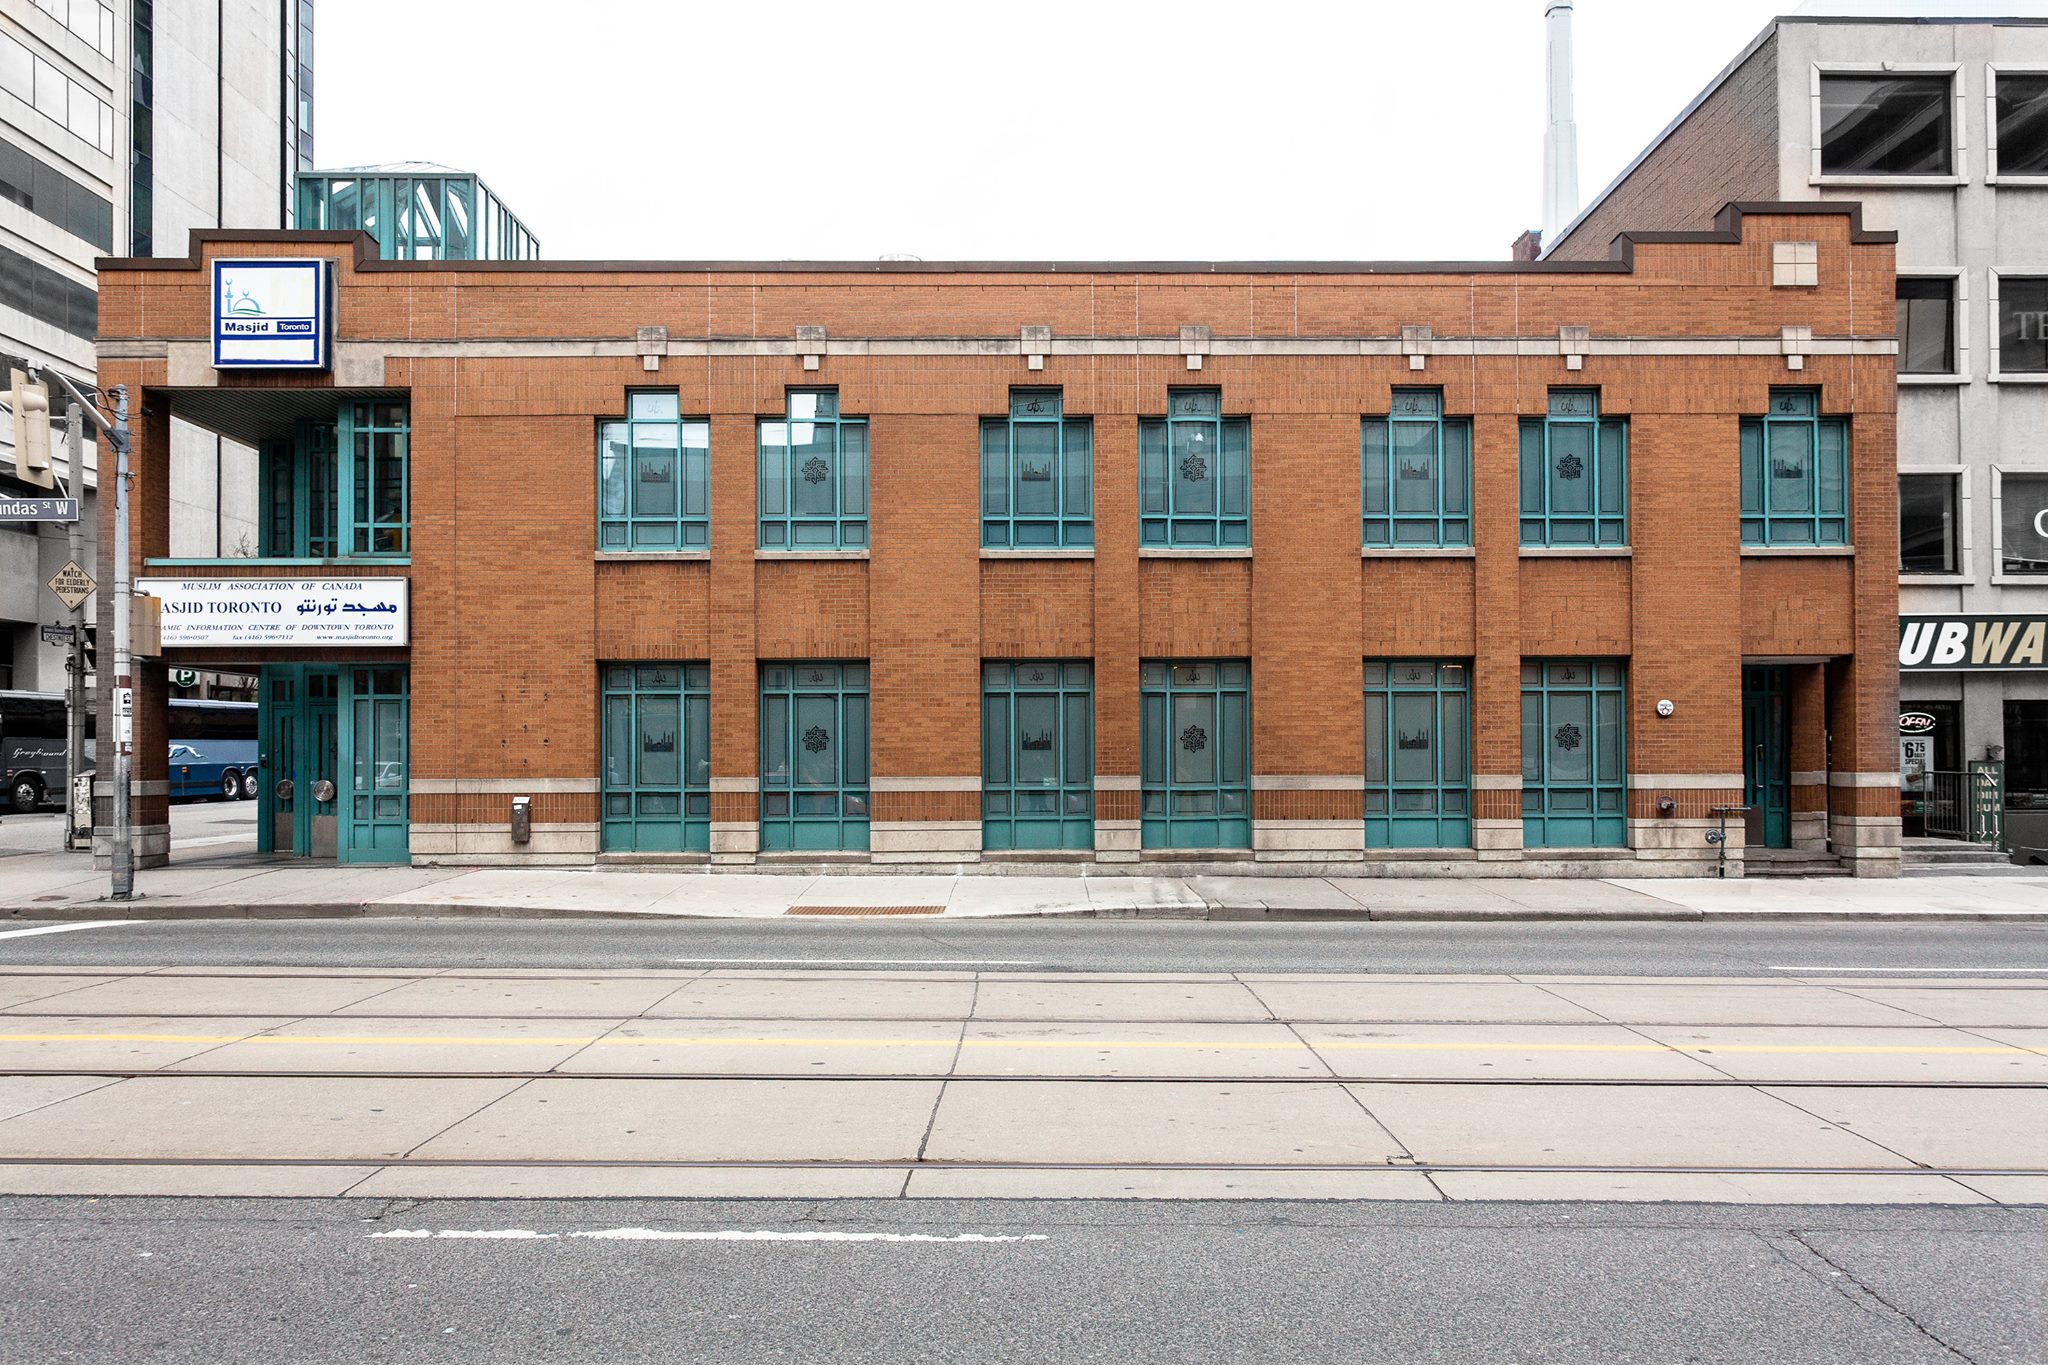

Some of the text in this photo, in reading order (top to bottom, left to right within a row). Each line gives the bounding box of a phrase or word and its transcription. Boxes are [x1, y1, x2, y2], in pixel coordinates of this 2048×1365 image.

[225, 322, 310, 333] Masjid Toronto
[0, 501, 69, 515] ndas St W
[62, 570, 83, 578] WATCH
[55, 578, 91, 587] FOR ELDERLY
[181, 582, 363, 591] MUSLIM ASSOCIATION OF CANADA
[55, 586, 90, 594] PEDESTRIANS
[161, 602, 282, 613] ASJID TORONTO
[296, 598, 398, 616] مسجد تورنتو
[244, 634, 263, 642] (416)
[1899, 622, 2047, 666] UBWA
[180, 669, 192, 681] P
[1899, 716, 1931, 727] OPEN
[12, 747, 67, 759] Greyhound
[1977, 766, 1999, 775] ALL
